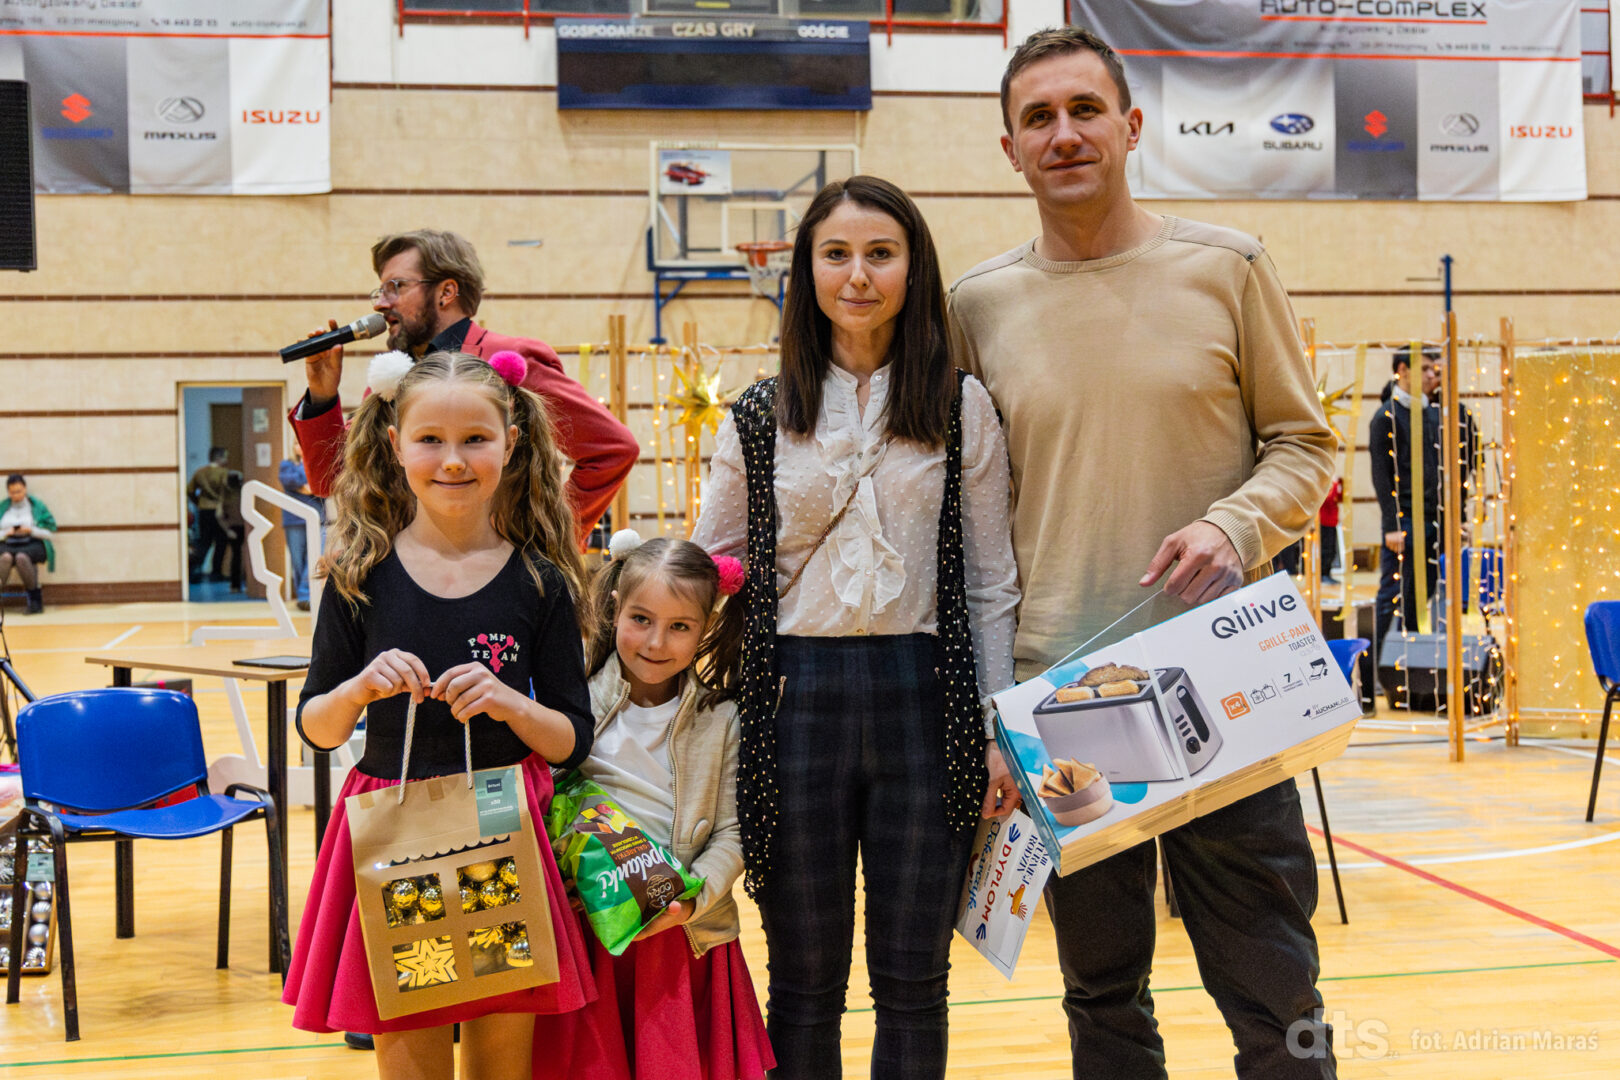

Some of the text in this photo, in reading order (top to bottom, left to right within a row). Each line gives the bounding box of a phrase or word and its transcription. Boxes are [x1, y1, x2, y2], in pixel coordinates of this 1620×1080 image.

[1260, 0, 1487, 17] AUTO-COMPLEX
[558, 25, 655, 38] GOSPODARZE
[671, 22, 756, 37] CZAS GRY
[797, 24, 849, 38] GOŚCIE
[243, 110, 321, 124] ISUZU
[144, 131, 217, 140] MAXUS
[1180, 121, 1235, 135] KIA
[1510, 126, 1572, 138] ISUZU
[1263, 141, 1323, 150] SUBARU
[1430, 144, 1489, 153] MAXUS
[1211, 594, 1297, 639] Qilive
[1258, 623, 1311, 652] GRILLE-PAIN
[1288, 634, 1317, 651] TOASTER
[595, 840, 681, 898] Opolanki
[967, 821, 1001, 912] Tokarczyk
[649, 882, 672, 898] ODRA
[981, 843, 1012, 922] DYPLOM
